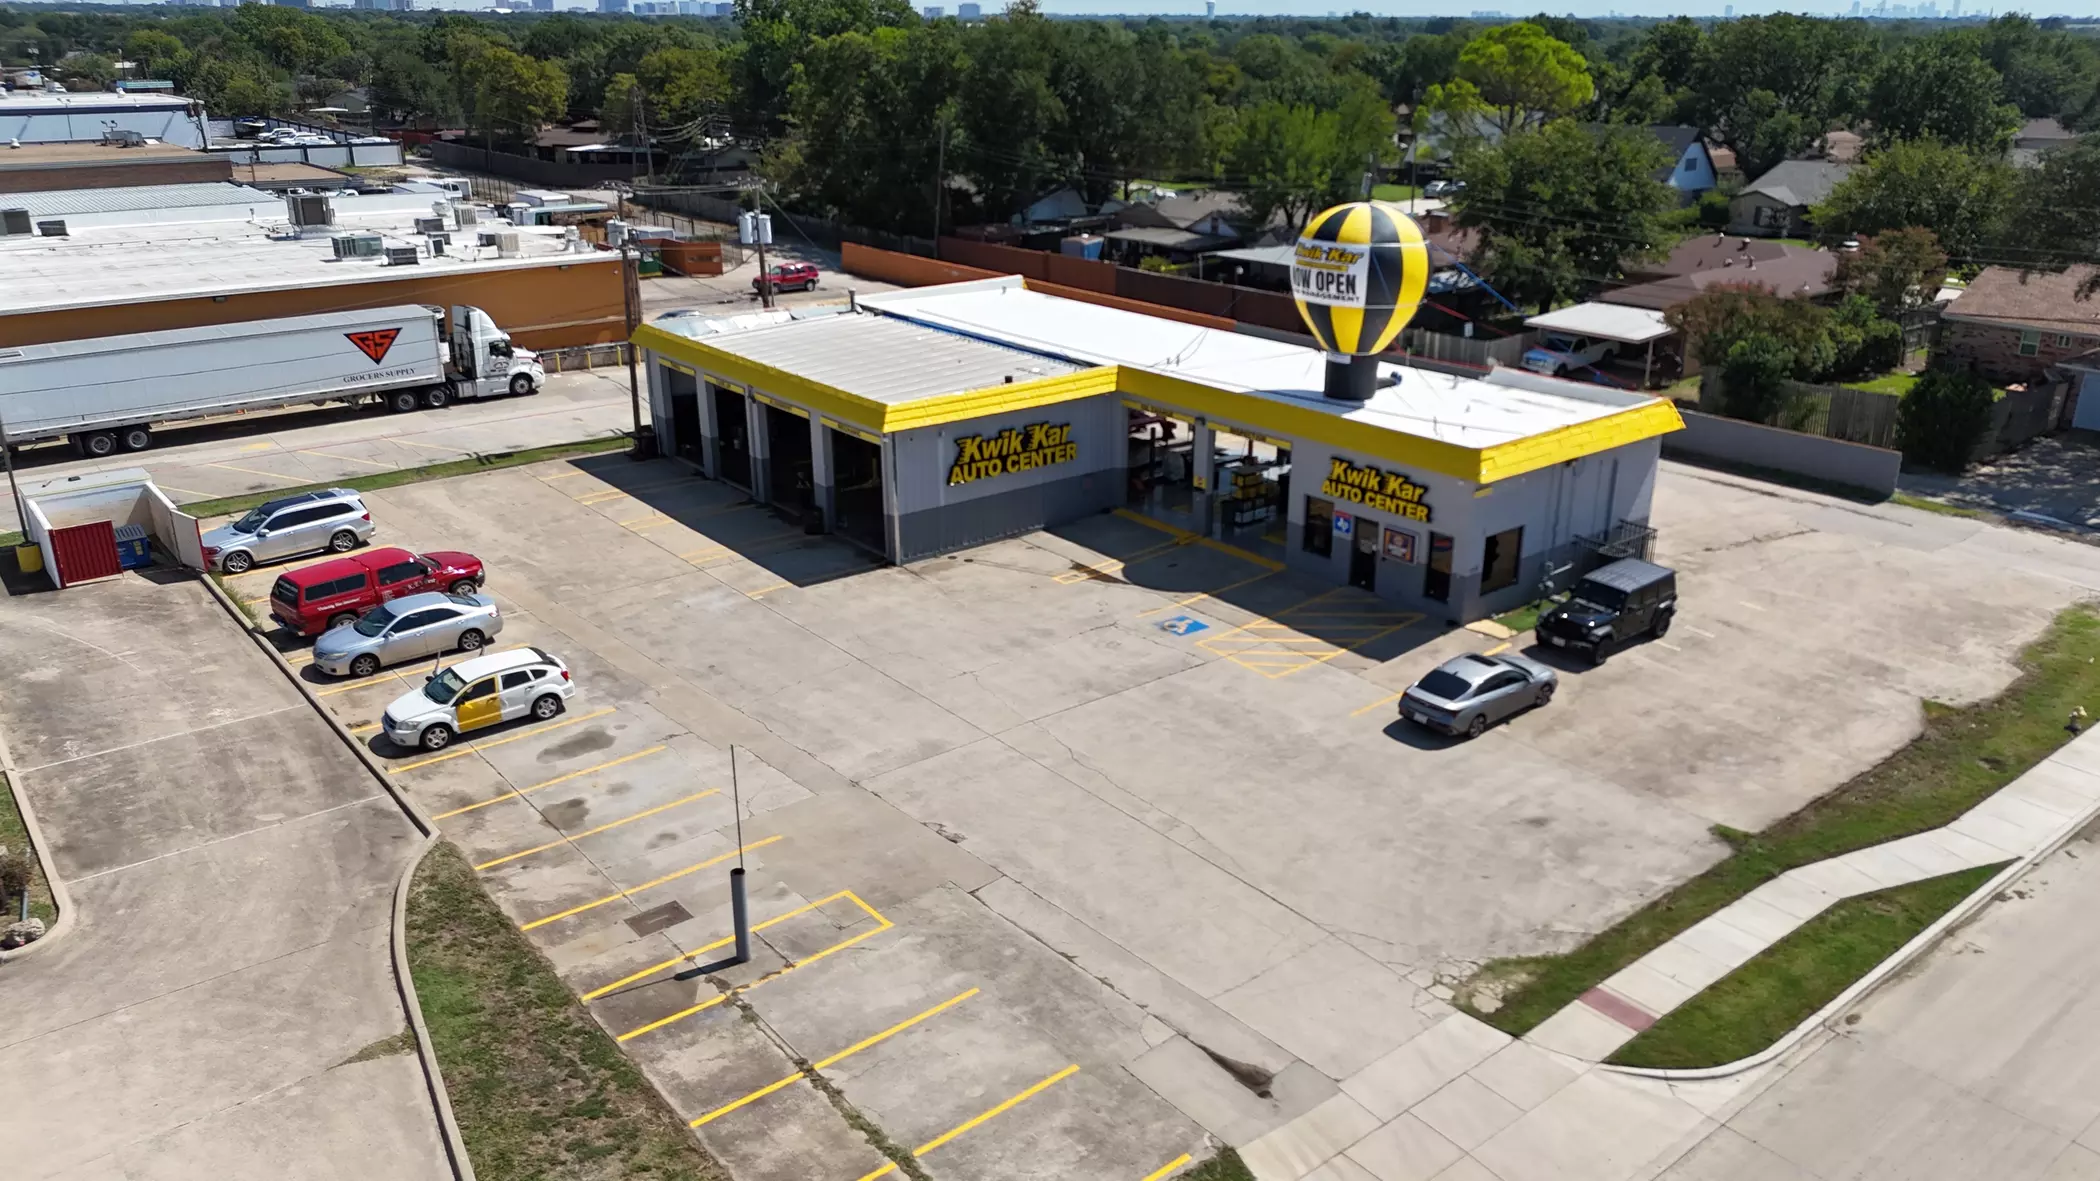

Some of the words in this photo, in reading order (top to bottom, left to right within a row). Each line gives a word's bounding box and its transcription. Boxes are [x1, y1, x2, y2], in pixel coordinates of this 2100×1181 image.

[1326, 247, 1362, 265] Kar
[1316, 271, 1356, 295] OPEN
[343, 371, 385, 383] GROCERS
[385, 367, 416, 378] SUPPLY
[956, 430, 1024, 464] Kwik
[1026, 421, 1073, 451] Kar
[949, 461, 1003, 485] AUTO
[1006, 443, 1077, 474] CENTER
[1331, 458, 1381, 492] Kwik
[1383, 473, 1426, 502] Kar
[1321, 479, 1362, 504] AUTO
[1364, 491, 1430, 523] CENTER
